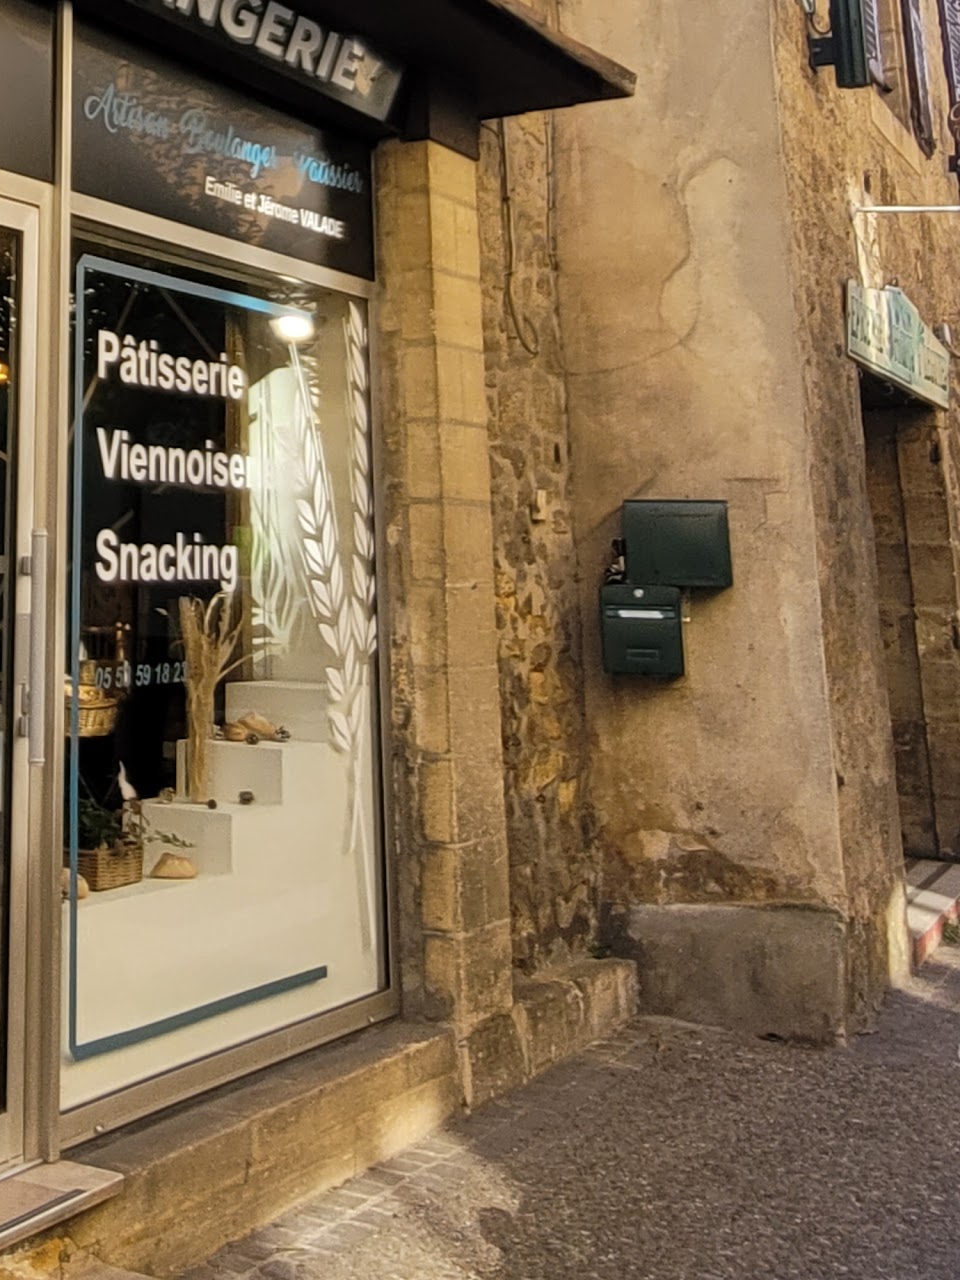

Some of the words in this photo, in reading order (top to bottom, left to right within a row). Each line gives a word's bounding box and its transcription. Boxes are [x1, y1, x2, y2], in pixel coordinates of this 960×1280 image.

[204, 175, 243, 206] Emilie
[244, 192, 257, 211] et
[300, 208, 344, 239] VALADE
[96, 328, 245, 400] Pâtisserie
[95, 528, 238, 592] Snacking
[135, 664, 152, 687] 59
[155, 662, 170, 684] 18
